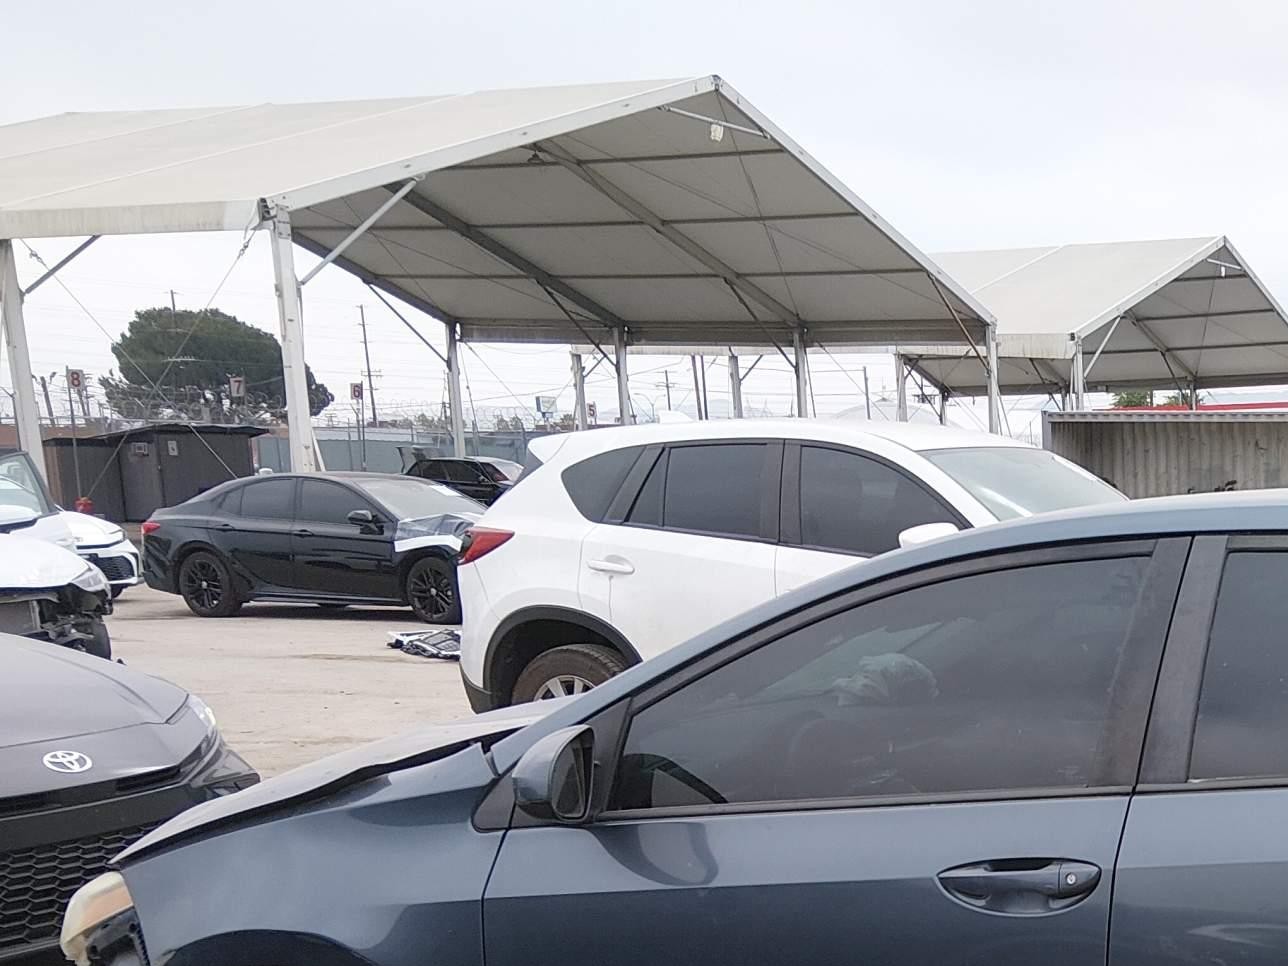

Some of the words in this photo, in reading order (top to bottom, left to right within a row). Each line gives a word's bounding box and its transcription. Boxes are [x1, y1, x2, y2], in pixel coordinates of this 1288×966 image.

[71, 371, 81, 387] 8
[234, 380, 242, 395] 7
[353, 385, 361, 398] 6
[588, 404, 595, 417] 5
